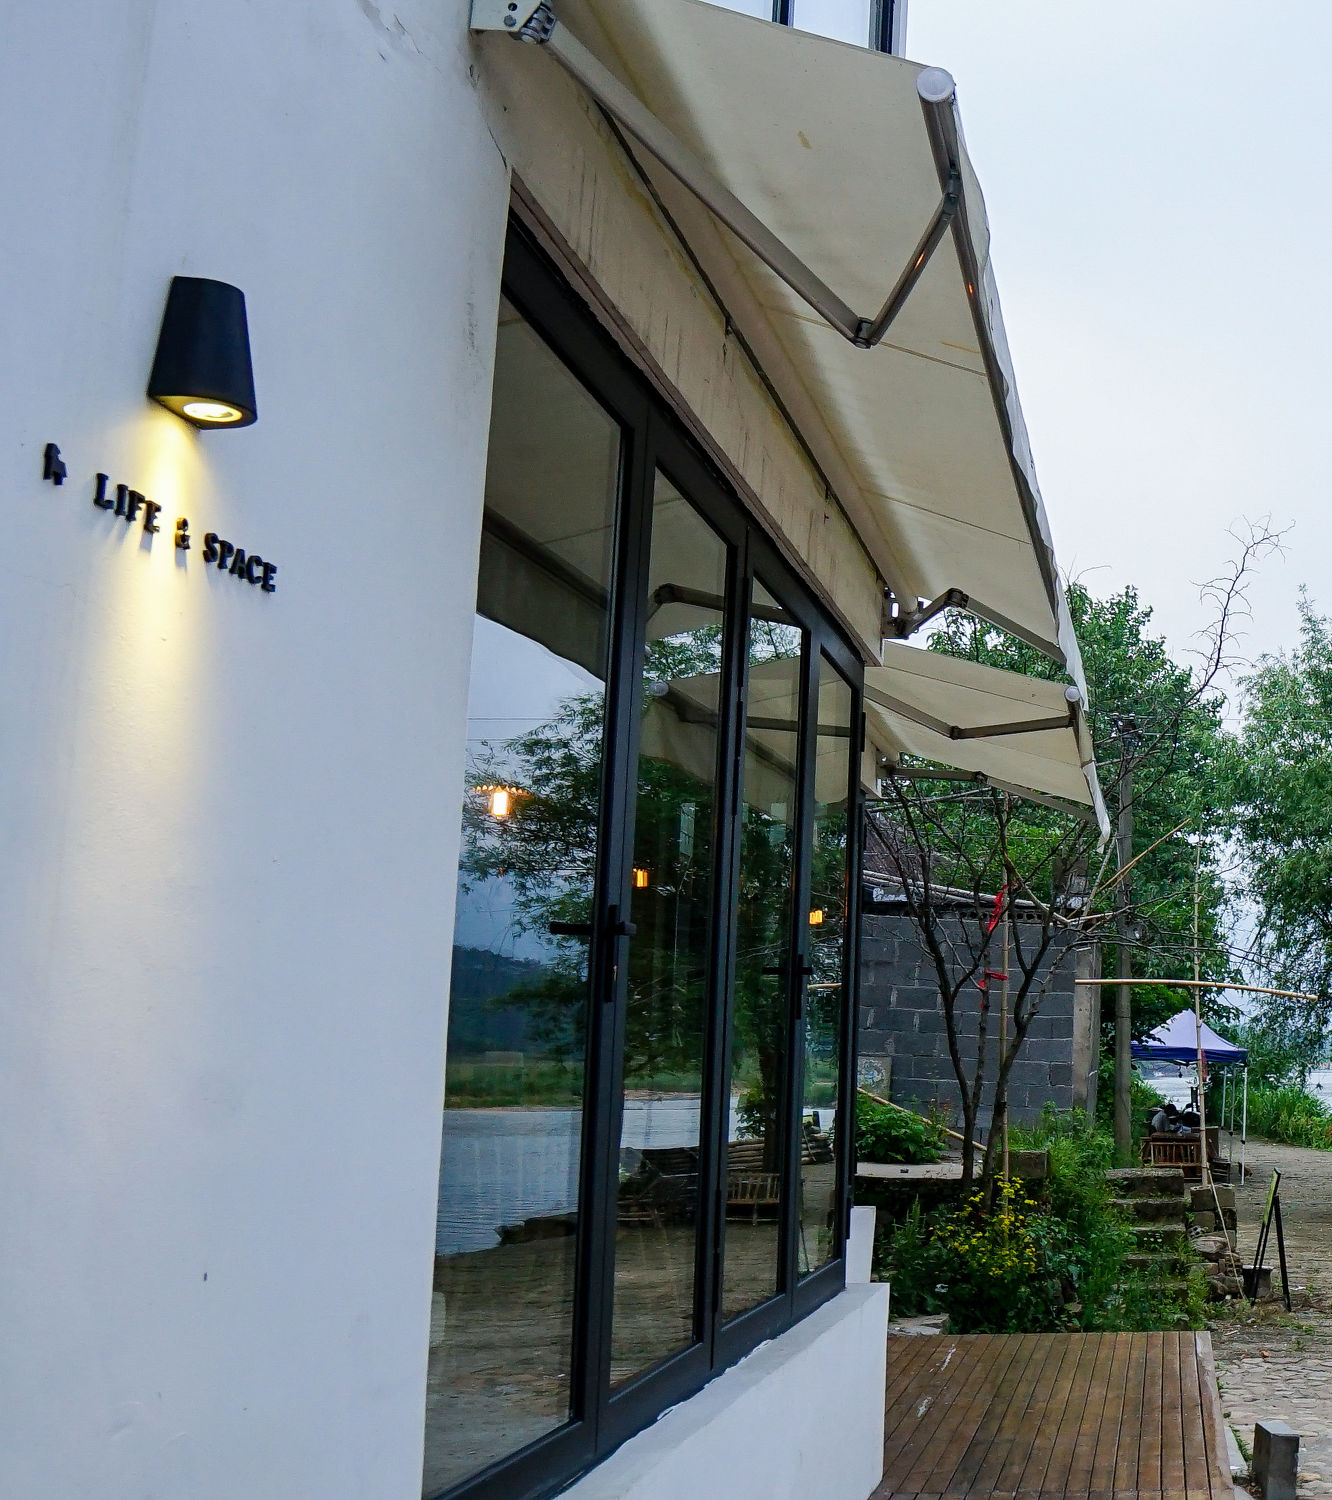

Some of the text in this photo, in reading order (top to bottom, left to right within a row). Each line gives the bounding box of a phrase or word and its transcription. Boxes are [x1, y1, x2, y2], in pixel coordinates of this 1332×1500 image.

[93, 472, 278, 593] LIFE & SPACE
